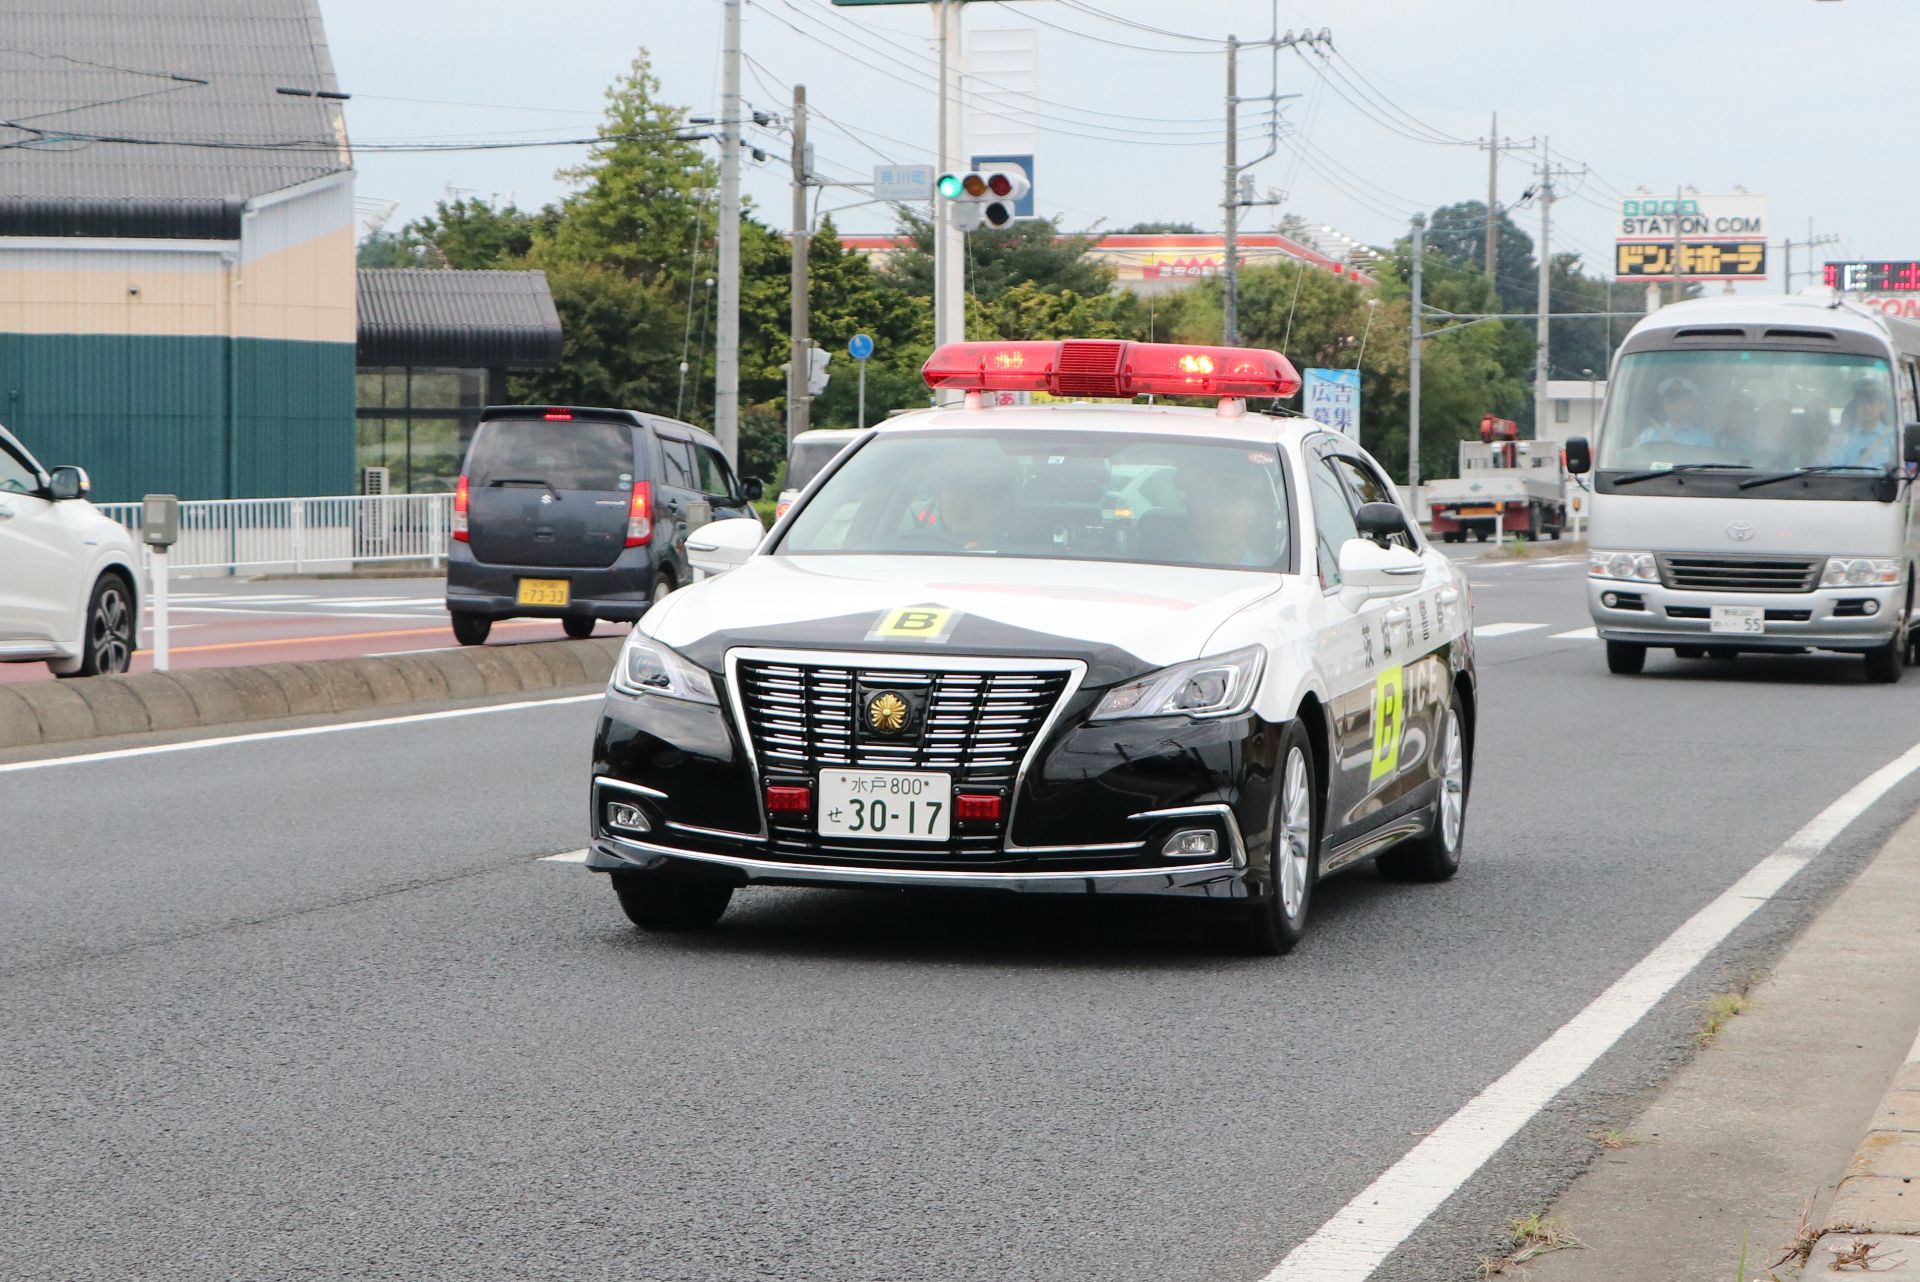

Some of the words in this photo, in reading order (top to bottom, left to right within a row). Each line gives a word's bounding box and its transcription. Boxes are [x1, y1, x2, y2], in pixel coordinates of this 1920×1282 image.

[1623, 217, 1709, 234] STATON
[1312, 382, 1353, 403] 広告
[893, 611, 939, 631] B
[1379, 682, 1397, 763] B
[826, 806, 843, 823] せ
[848, 798, 943, 835] 30-17
